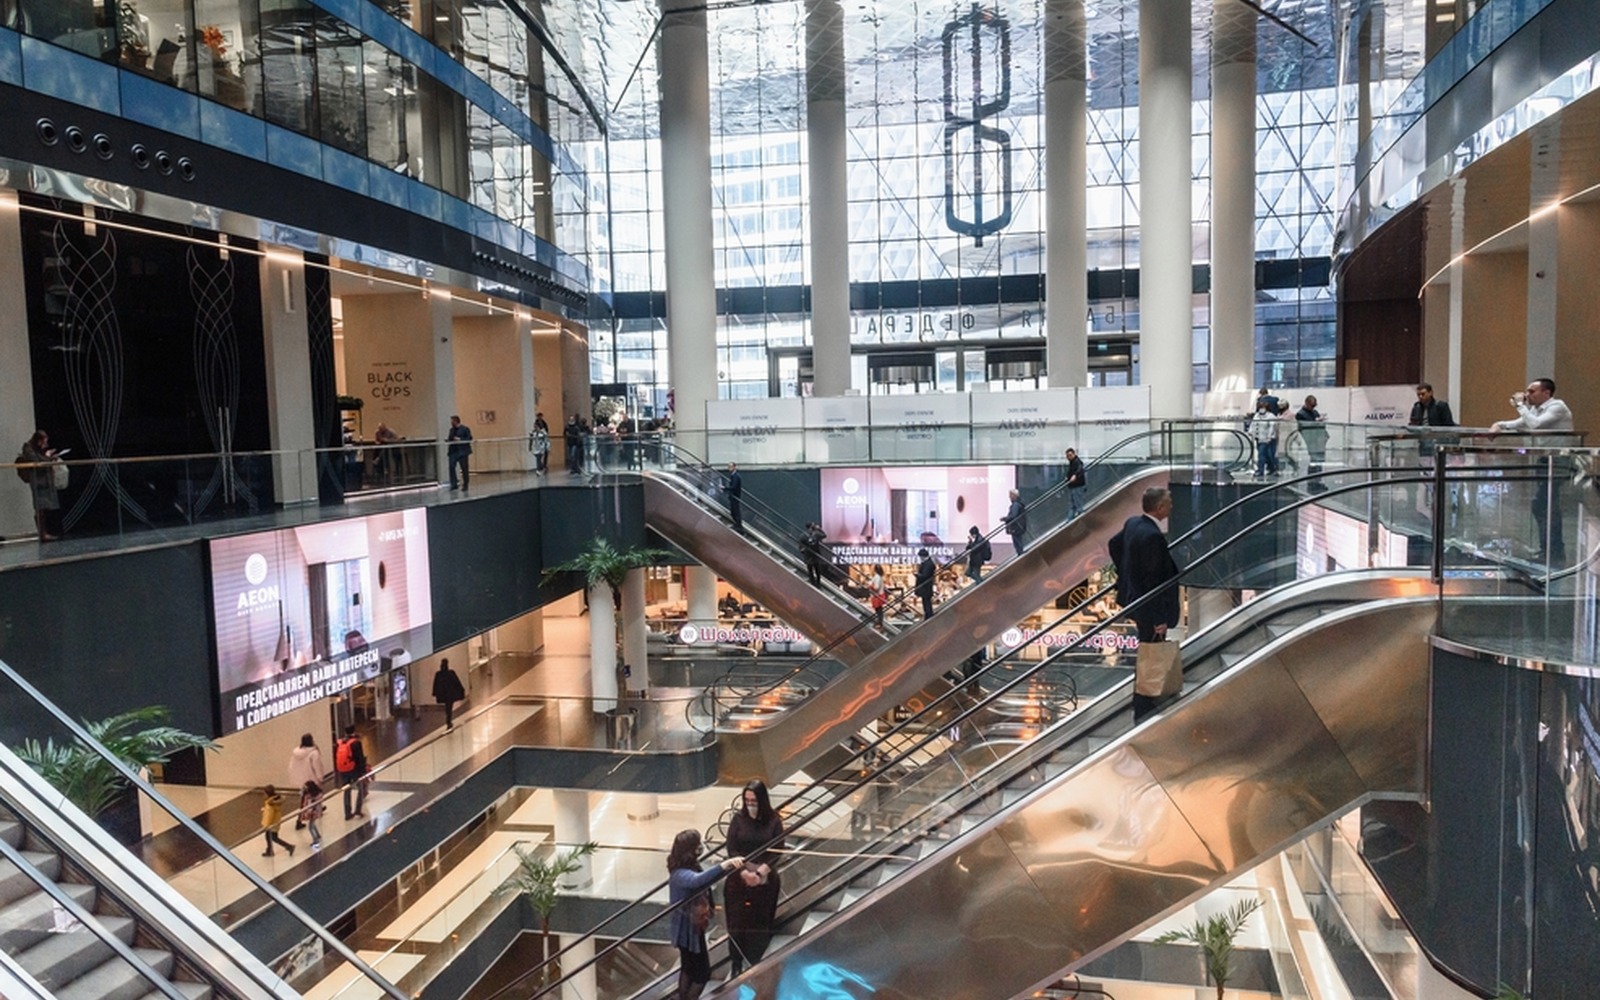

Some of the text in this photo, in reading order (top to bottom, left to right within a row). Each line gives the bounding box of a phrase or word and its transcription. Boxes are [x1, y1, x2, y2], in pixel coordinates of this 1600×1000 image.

[367, 371, 412, 383] BLACK
[836, 496, 866, 504] AEON
[915, 546, 954, 555] ИТЕРЕСЫ
[237, 585, 279, 610] AEON
[236, 648, 379, 712] ПРЕДСТАВЛЯЕМ ВАШИ ИНТЕРЕСЫ
[236, 672, 357, 730] И СОПРОВОЖДАЕМ СДЕЛКИ
